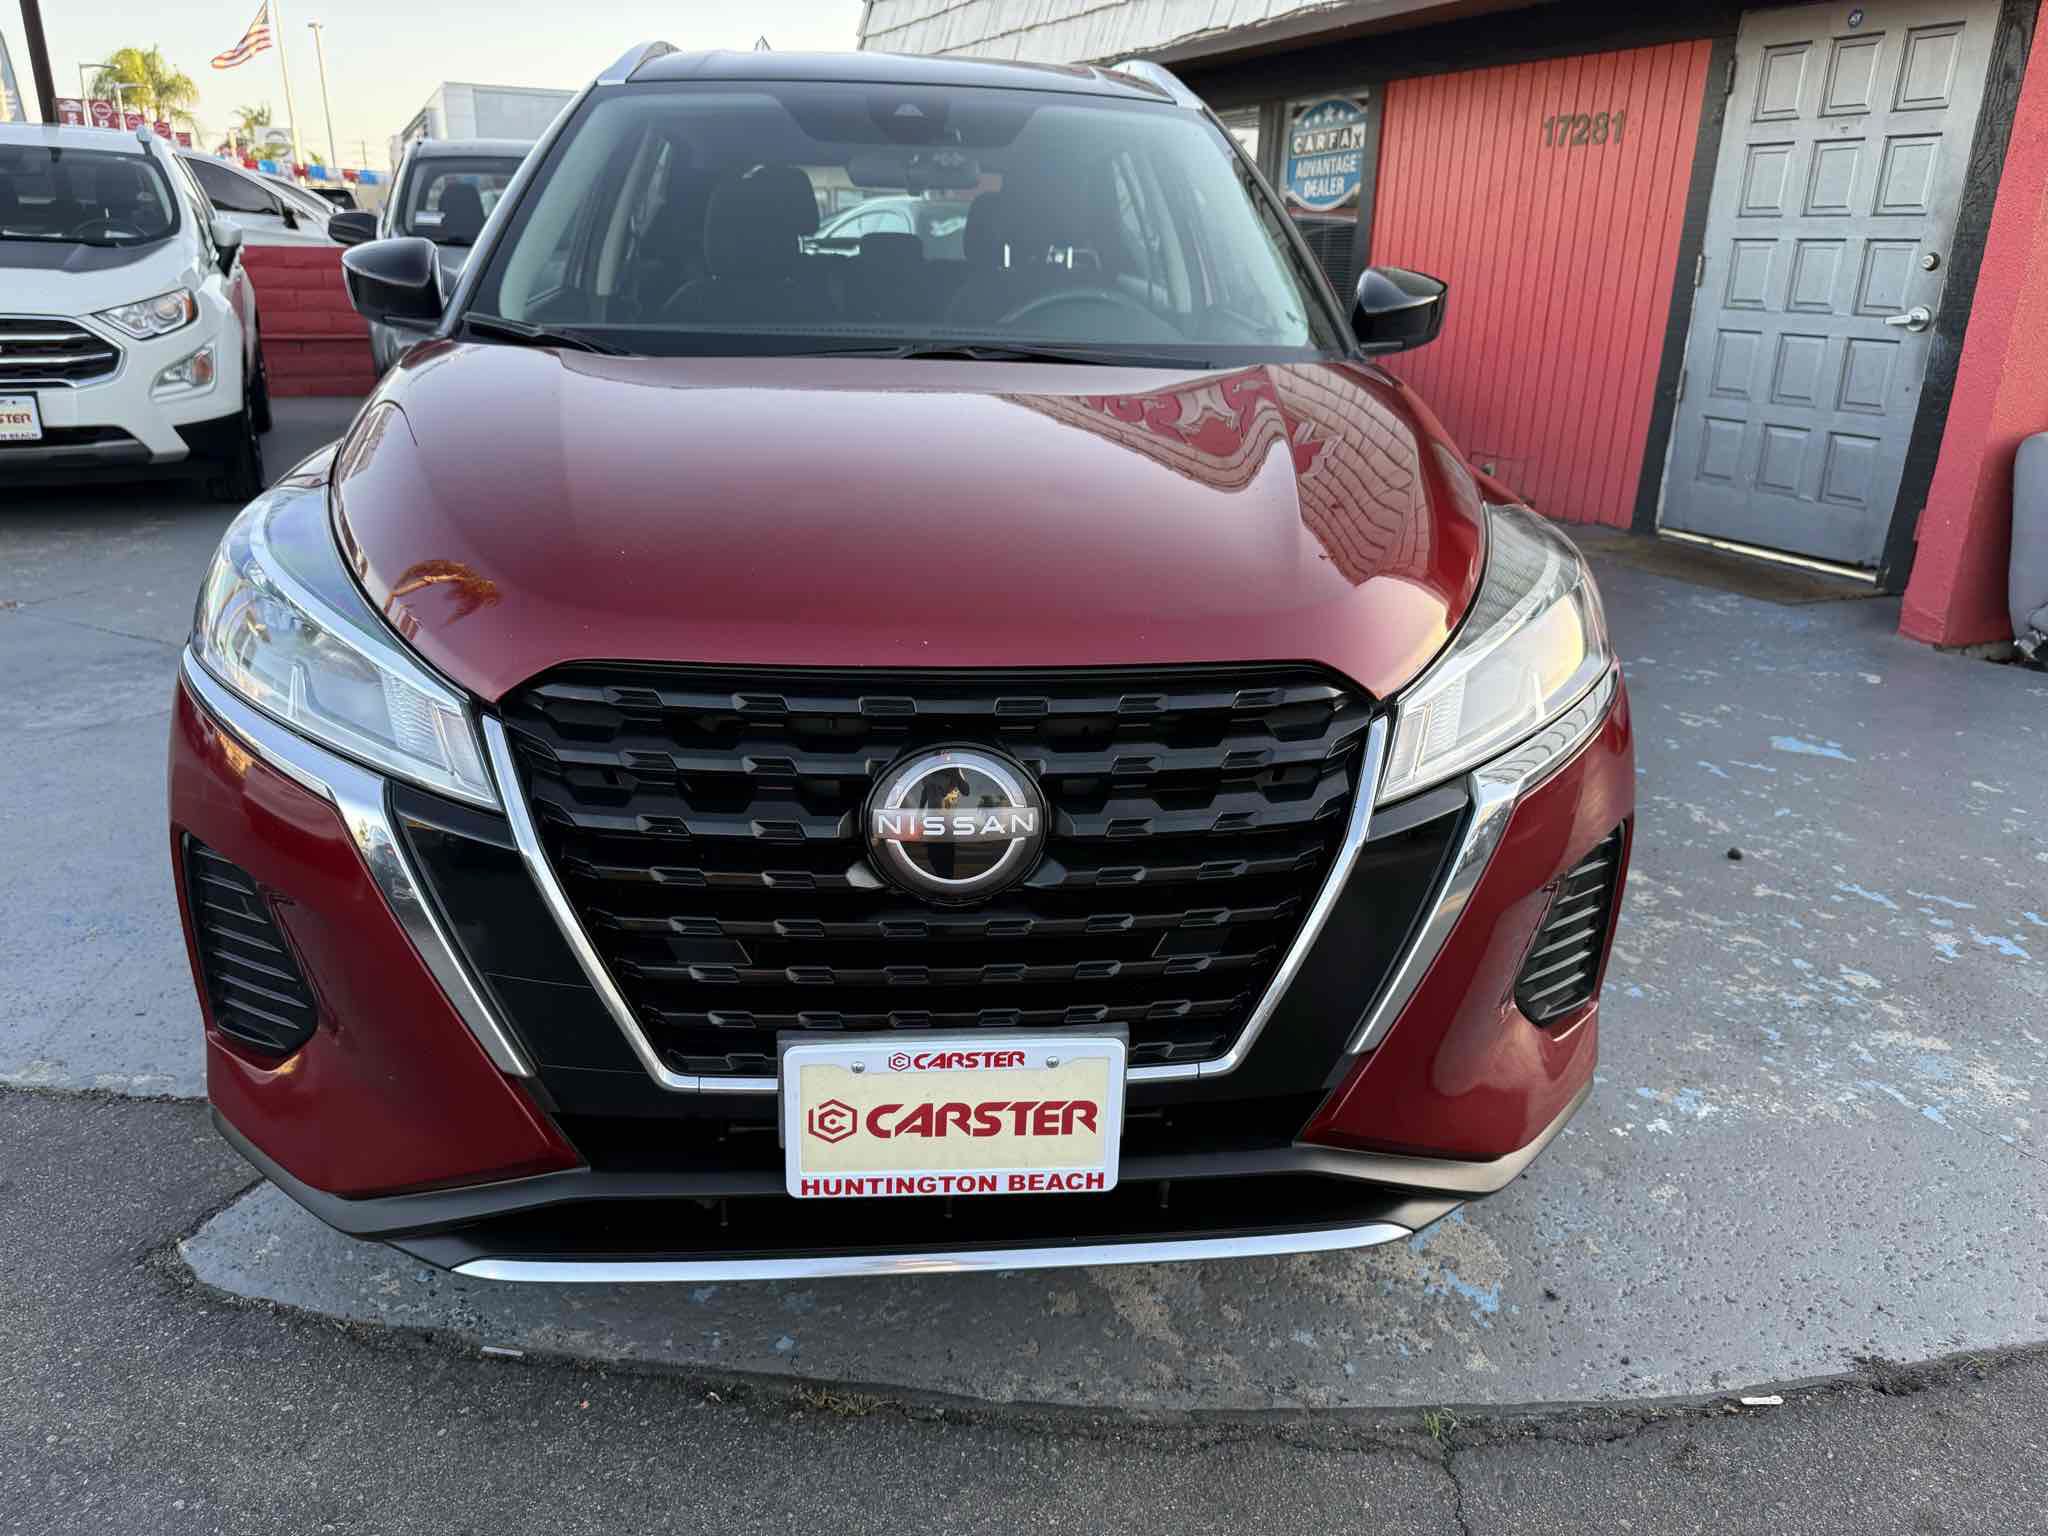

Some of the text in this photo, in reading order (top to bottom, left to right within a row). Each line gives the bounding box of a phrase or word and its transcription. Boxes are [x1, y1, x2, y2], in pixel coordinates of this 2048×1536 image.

[1295, 124, 1366, 155] CARFAX
[1543, 110, 1624, 146] 17281
[1296, 154, 1356, 178] ADVANTAGE
[1304, 176, 1345, 198] DEALER
[878, 814, 1034, 835] NISSAN
[913, 1051, 1025, 1070] CARSTER
[867, 1099, 1098, 1139] CARSTER
[801, 1172, 1105, 1197] HUNTINGTON BEACH
